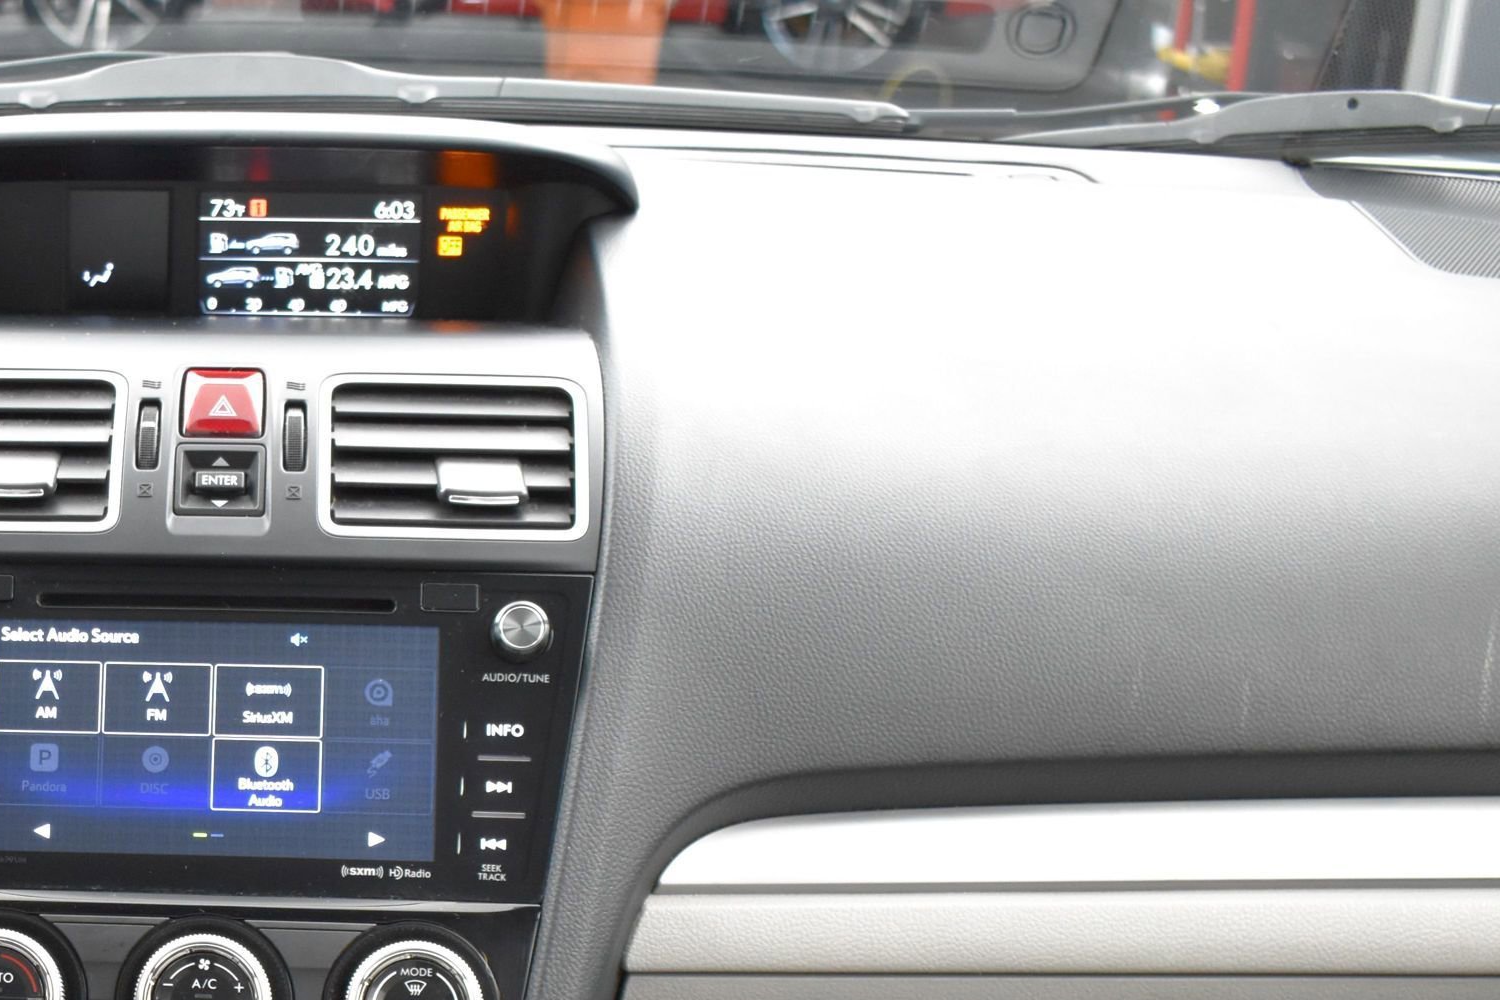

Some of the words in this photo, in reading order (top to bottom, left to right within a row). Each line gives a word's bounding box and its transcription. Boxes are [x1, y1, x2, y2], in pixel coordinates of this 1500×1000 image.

[374, 201, 415, 220] 6:03
[325, 233, 375, 257] 240
[326, 267, 374, 290] 23.4
[201, 474, 238, 486] ENTER
[1, 627, 44, 642] Select
[47, 628, 89, 643] Audio
[91, 630, 139, 644] Source
[482, 672, 550, 684] AUDIO/TUNE
[35, 706, 57, 719] AM
[146, 709, 167, 721] FM
[242, 711, 293, 724] SiriusXM
[486, 723, 525, 737] INFO
[21, 780, 67, 793] Pandora
[140, 783, 169, 795] DISC
[238, 778, 294, 791] Bluetooth
[365, 787, 390, 800] USB
[248, 795, 283, 808] Audio
[404, 868, 431, 879] Radio
[481, 864, 502, 873] SEEK
[477, 872, 507, 881] TRACK
[400, 966, 434, 979] MODE
[190, 979, 217, 991] A/C
